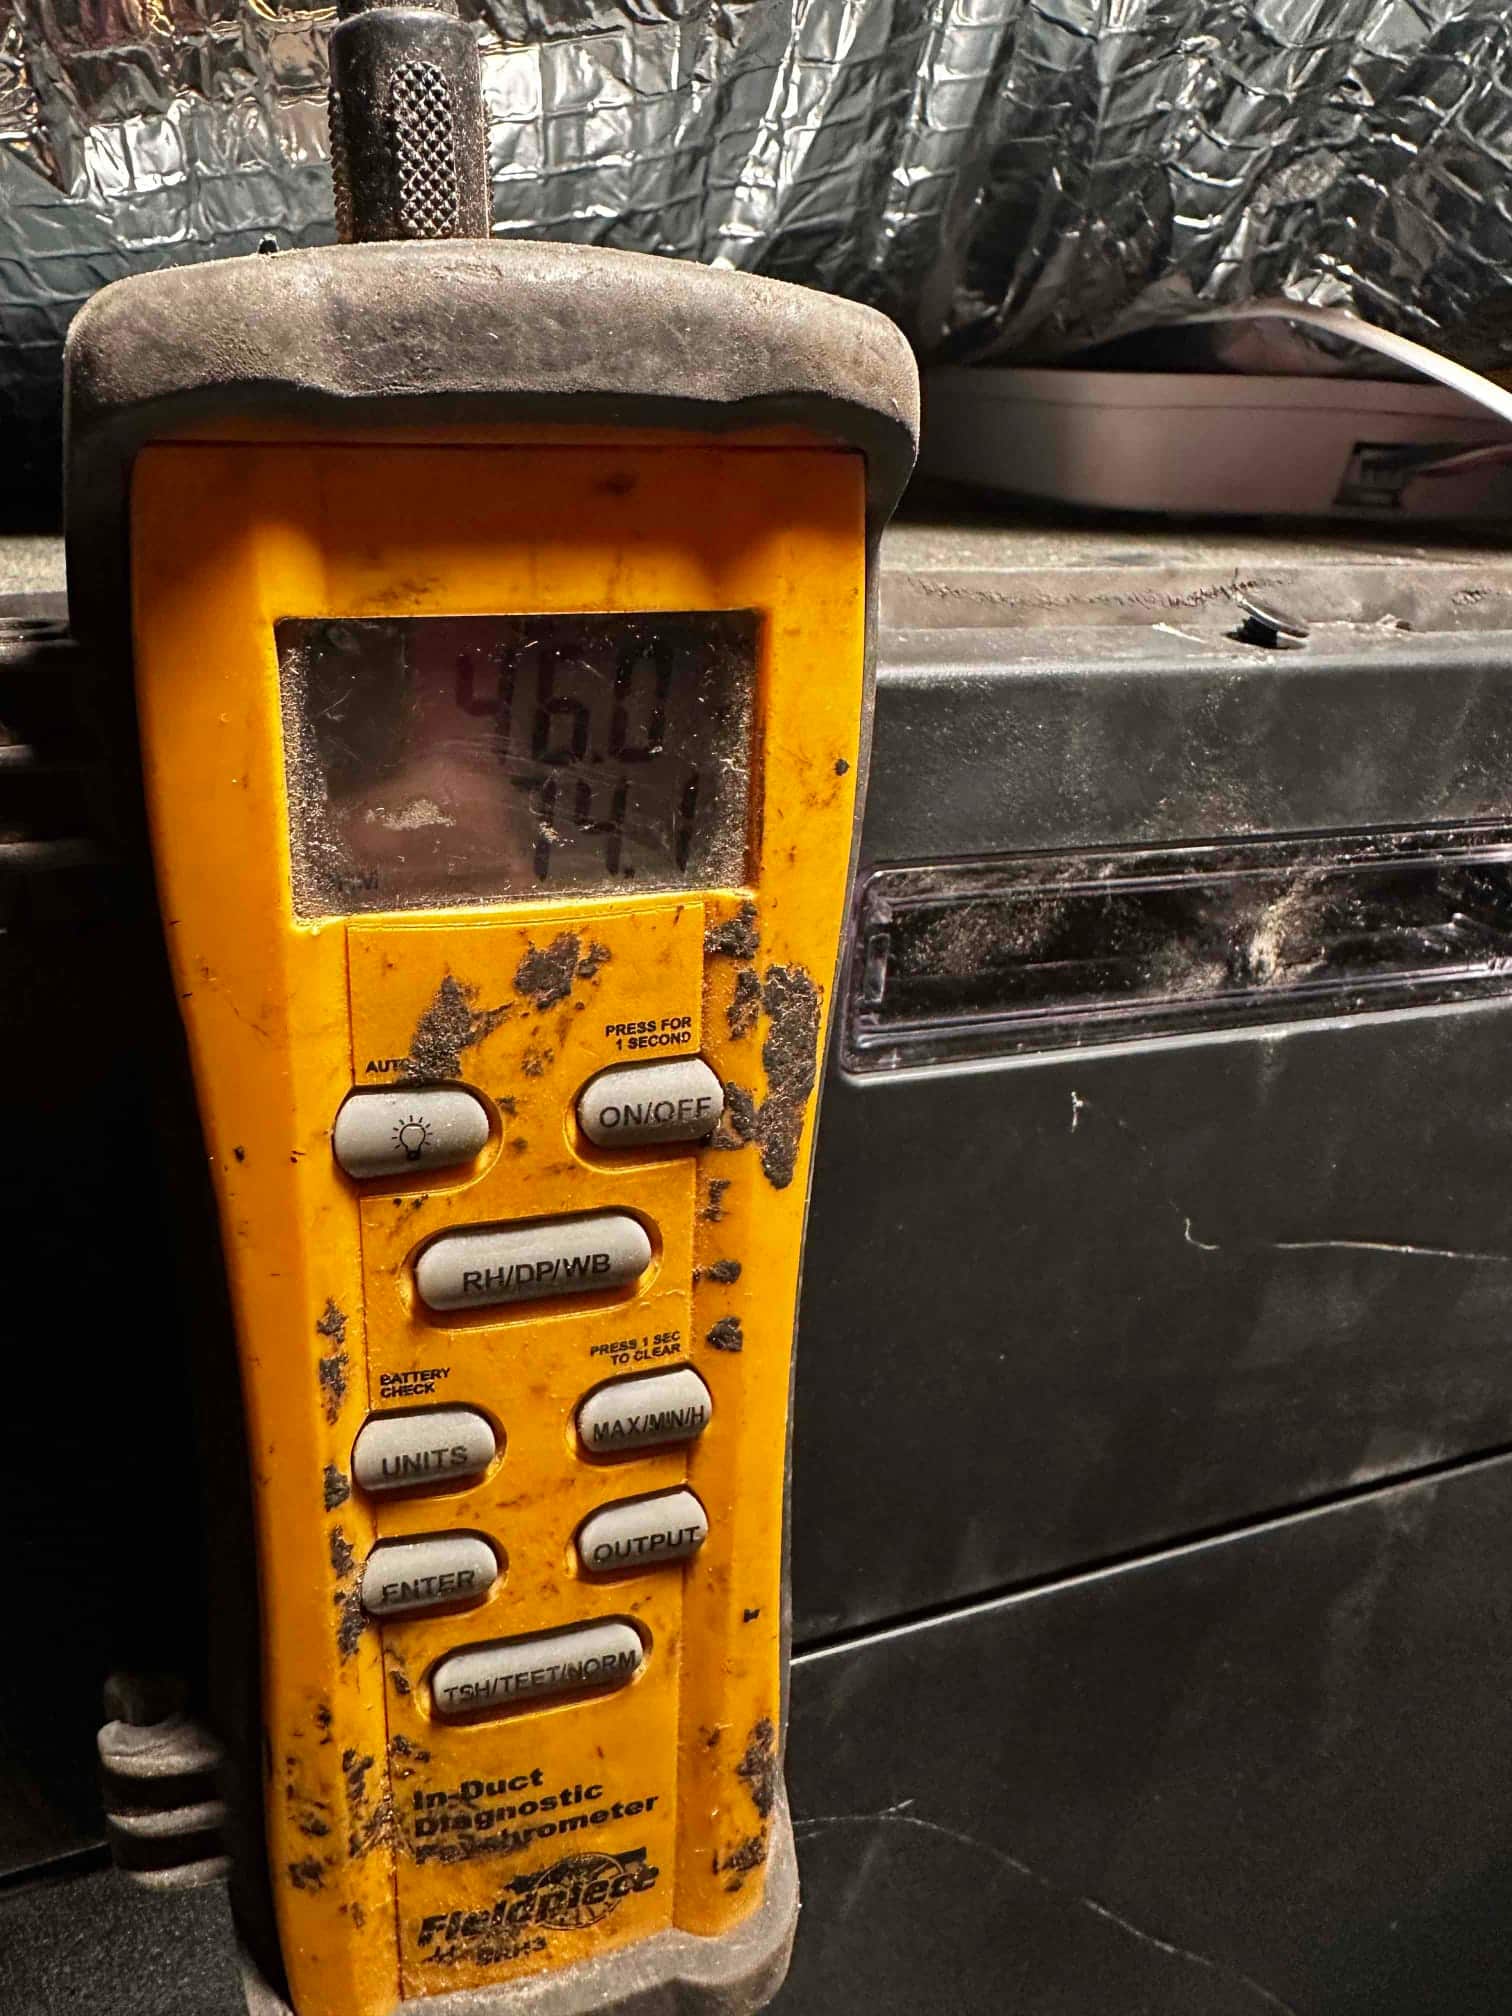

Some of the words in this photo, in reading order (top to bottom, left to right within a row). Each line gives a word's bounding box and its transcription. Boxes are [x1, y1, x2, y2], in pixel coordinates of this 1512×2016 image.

[605, 1020, 657, 1037] PRESS
[660, 1016, 692, 1034] FOR
[616, 1039, 623, 1051] 1
[627, 1031, 691, 1050] SECOND
[600, 1096, 712, 1129] ON/OFF
[462, 1252, 612, 1292] RH/DP/WB
[590, 1338, 637, 1357] PRESS
[641, 1336, 648, 1348] 1
[653, 1330, 681, 1346] SEC
[611, 1349, 631, 1364] TO
[634, 1342, 681, 1362] CLEAR
[380, 1367, 450, 1386] BATTERY
[380, 1381, 435, 1398] CHECK
[593, 1405, 704, 1442] MAX/MIN/H
[381, 1446, 468, 1477] UNITS
[593, 1526, 700, 1562] OUTPUT
[382, 1570, 475, 1600] ENTER
[413, 1768, 544, 1810] In-Duct
[415, 1783, 603, 1838] Diagnostic
